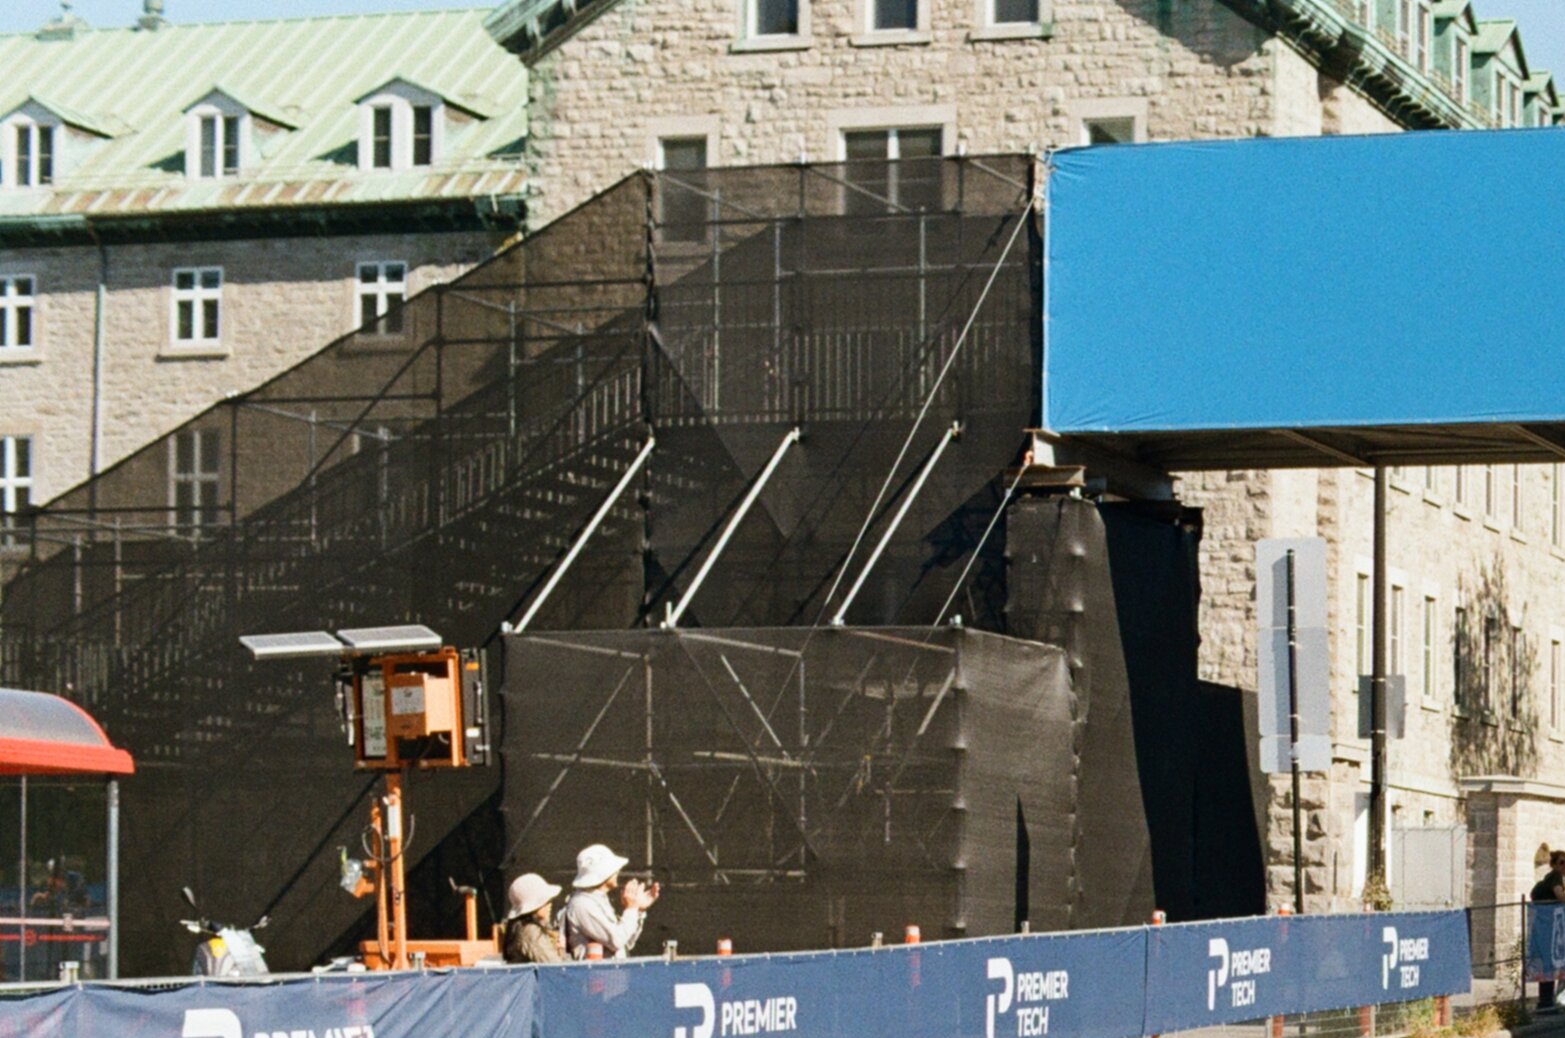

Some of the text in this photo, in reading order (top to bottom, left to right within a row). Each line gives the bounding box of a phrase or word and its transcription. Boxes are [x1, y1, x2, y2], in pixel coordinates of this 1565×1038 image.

[1231, 947, 1270, 977] PREMIER
[1400, 937, 1429, 961] PREMIER
[1017, 970, 1068, 1002] PREMIER
[1400, 965, 1419, 988] TECH
[1231, 979, 1255, 1007] TECH
[721, 996, 797, 1037] PREMIER
[1017, 1006, 1049, 1037] TECH
